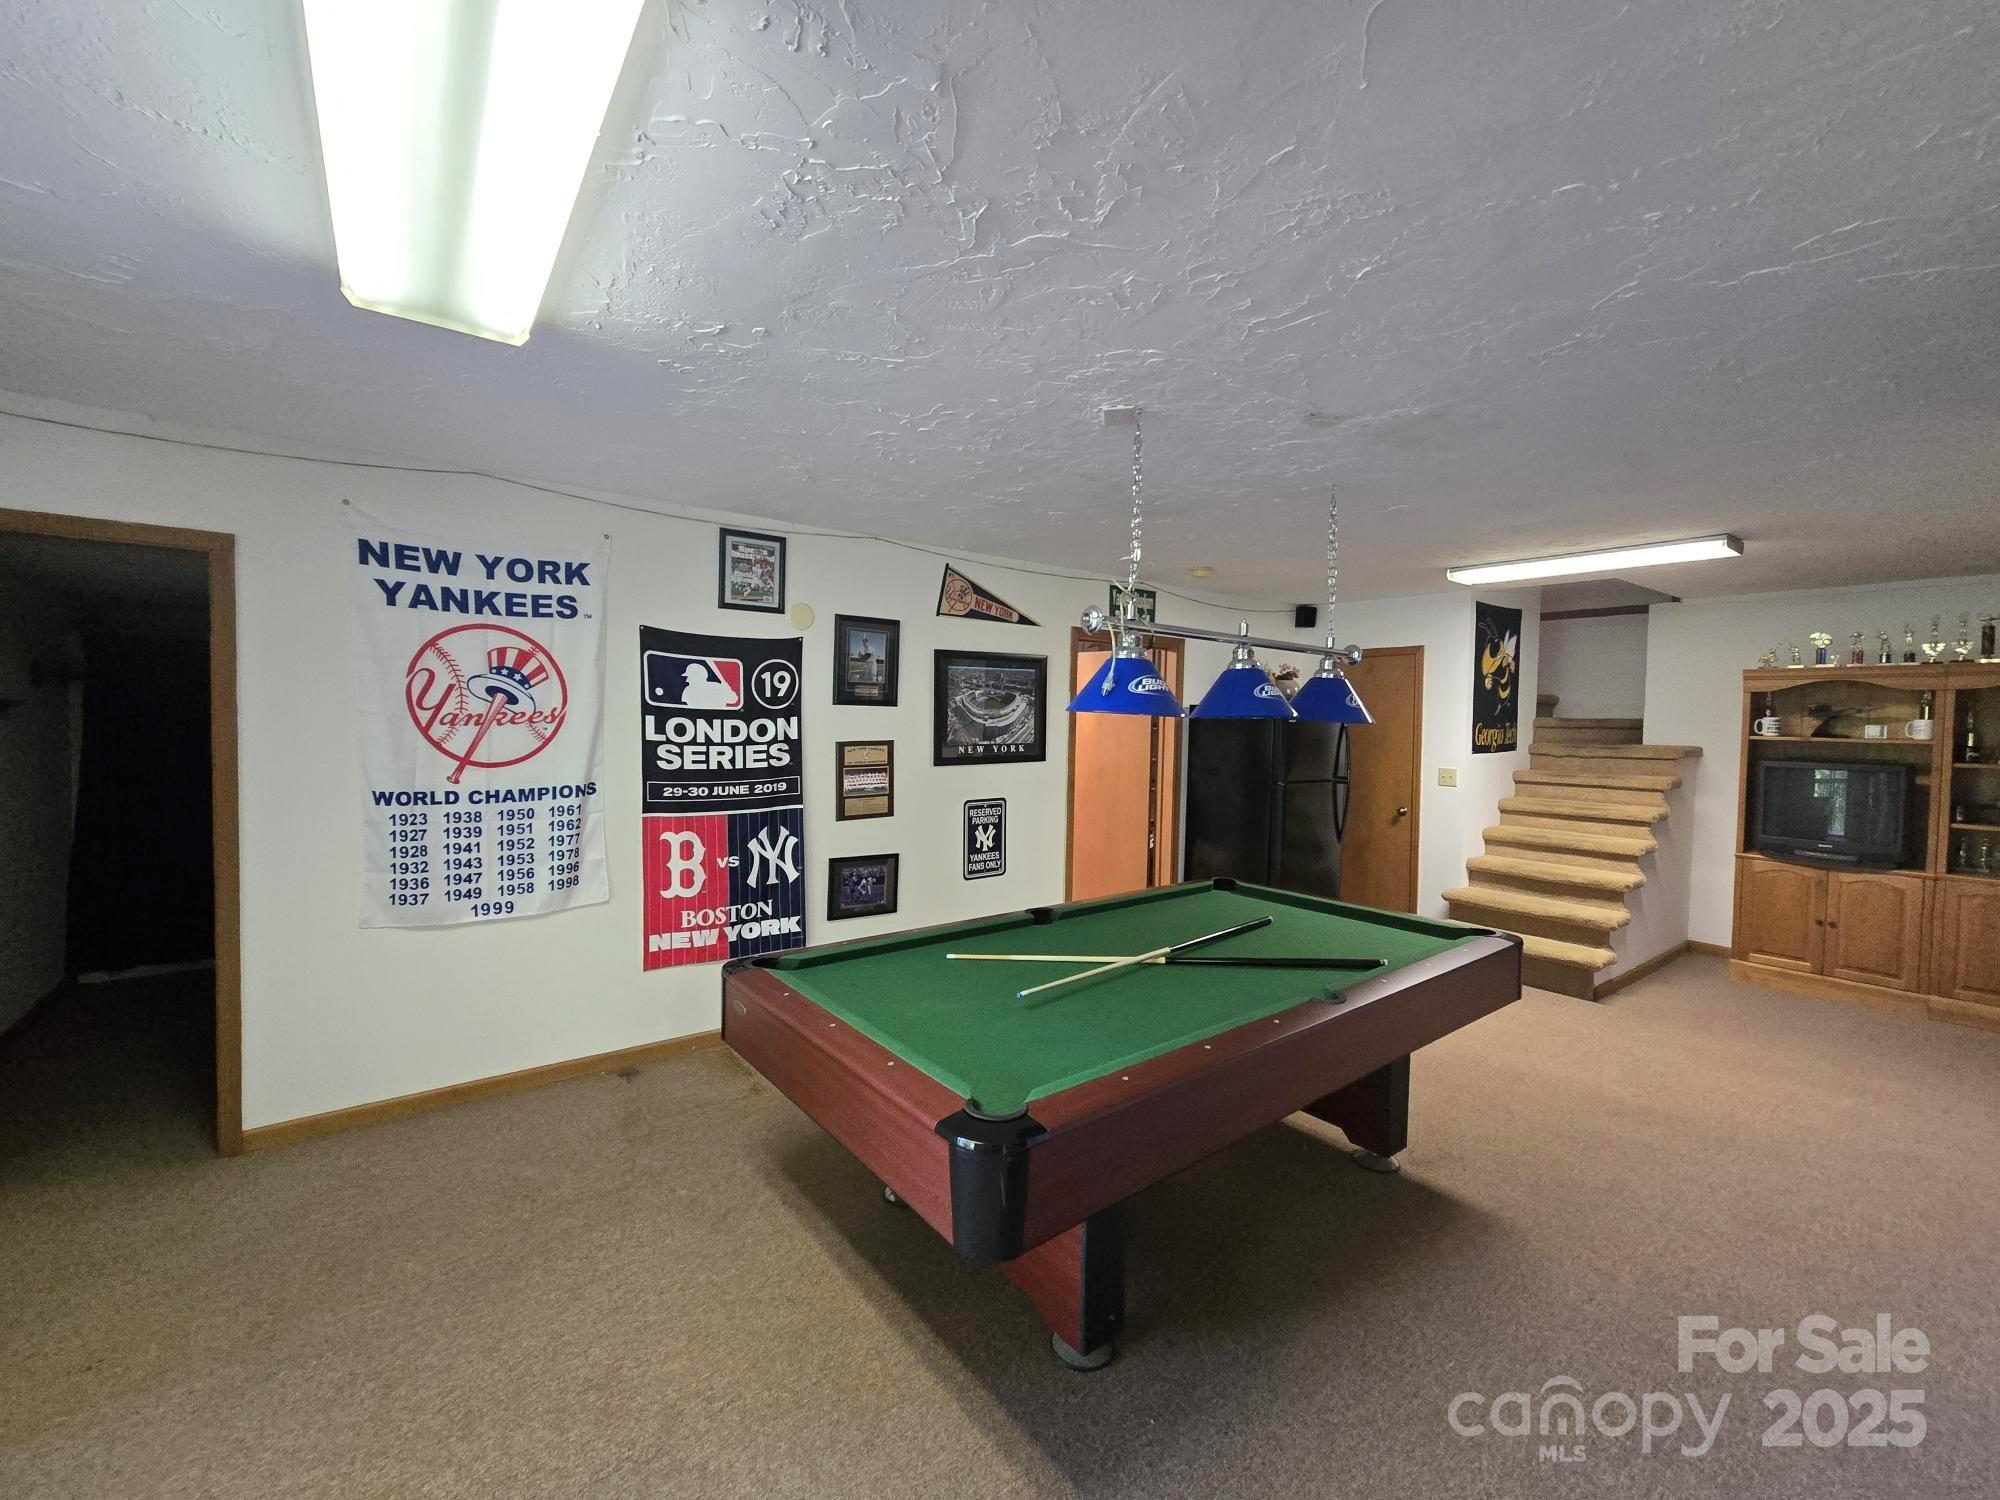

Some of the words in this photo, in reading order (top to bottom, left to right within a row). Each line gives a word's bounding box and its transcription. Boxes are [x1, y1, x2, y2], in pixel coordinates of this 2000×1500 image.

[357, 538, 462, 576] NEW
[475, 554, 591, 586] YORK
[374, 578, 578, 619] YANKEES
[975, 596, 993, 613] NEW
[995, 604, 1013, 620] YORK
[761, 670, 791, 698] 19
[1142, 678, 1167, 686] BUD
[405, 667, 560, 733] Yankees
[645, 715, 798, 744] LONDON
[1475, 722, 1503, 752] Georgia
[656, 742, 791, 771] SERIES
[958, 744, 985, 754] NEW
[992, 743, 1025, 752] YORK
[372, 790, 459, 806] WORLD
[468, 781, 597, 805] CHAMPIONS
[663, 786, 708, 797] 29-30
[712, 784, 749, 796] JUNE
[754, 782, 787, 793] 2019
[389, 813, 428, 826] 1923
[443, 811, 482, 824] 1938
[497, 808, 535, 821] 1950
[549, 803, 582, 817] 1961
[969, 807, 1002, 817] RESERVED
[972, 815, 998, 825] PARKING
[389, 829, 427, 842] 1927
[443, 826, 483, 839] 1939
[497, 823, 533, 836] 1951
[549, 818, 582, 832] 1962
[974, 824, 997, 852] NY
[389, 846, 428, 859] 1928
[443, 842, 481, 855] 1941
[497, 838, 535, 851] 1952
[549, 833, 580, 847] 1977
[969, 851, 1000, 862] YANKEES
[390, 861, 429, 875] 1932
[443, 857, 483, 870] 1943
[497, 853, 535, 866] 1953
[549, 848, 580, 862] 1978
[660, 831, 707, 899] B
[747, 825, 800, 888] NY
[968, 861, 985, 872] FANS
[985, 860, 1002, 870] ONLY
[389, 877, 430, 890] 1936
[443, 872, 483, 886] 1947
[497, 868, 535, 881] 1956
[549, 862, 580, 876] 1996
[389, 893, 429, 906] 1937
[444, 887, 482, 902] 1949
[497, 883, 535, 896] 1958
[548, 877, 580, 892] 1998
[470, 901, 515, 917] 1999
[681, 899, 773, 928] BOSTON
[649, 929, 719, 952] NEW
[724, 916, 802, 942] YORK
